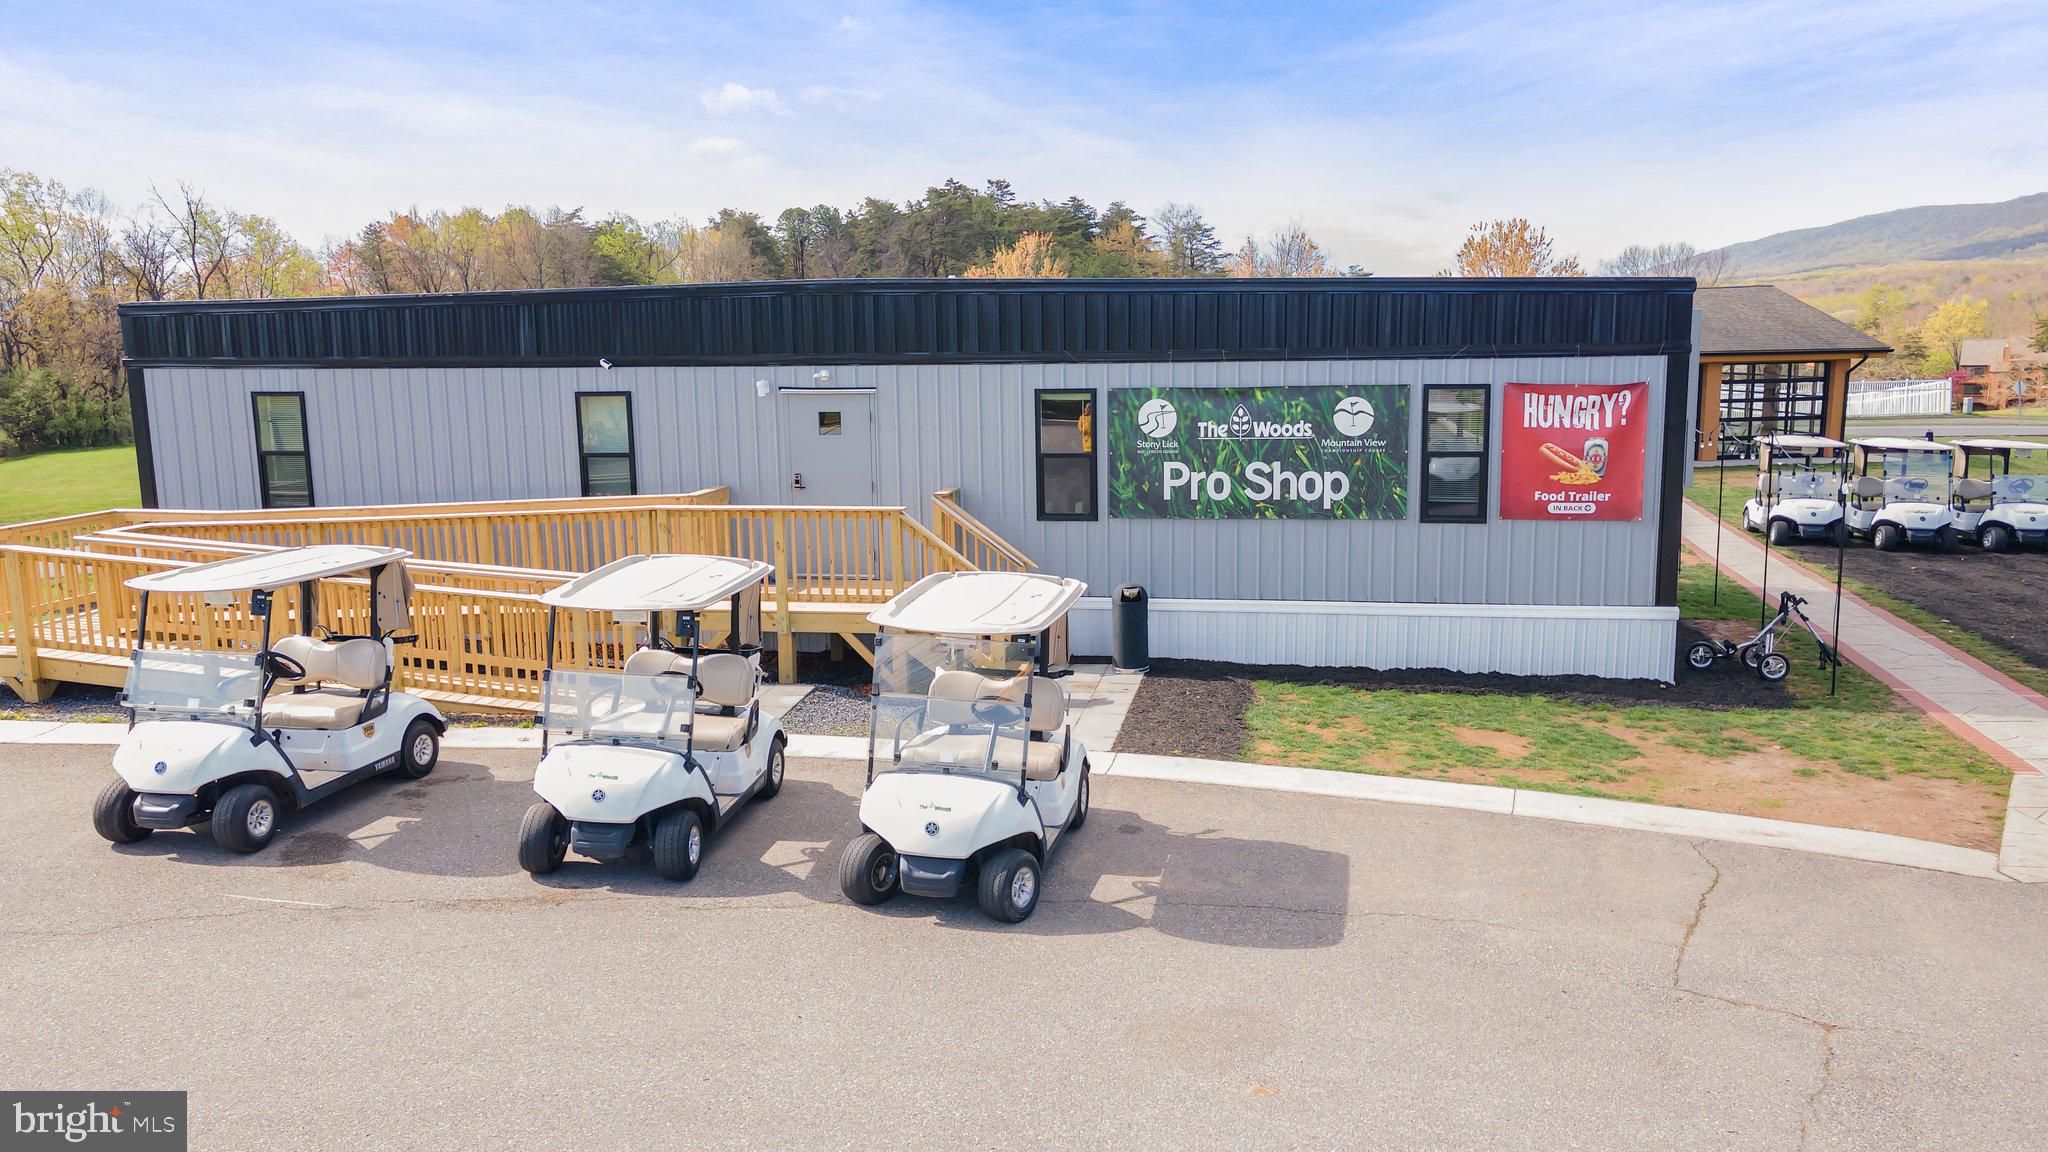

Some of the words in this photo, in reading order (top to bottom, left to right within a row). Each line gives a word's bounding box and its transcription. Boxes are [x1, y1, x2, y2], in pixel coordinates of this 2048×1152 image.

[1523, 390, 1632, 431] HUNGRY?
[1197, 421, 1228, 438] The
[1252, 420, 1313, 438] Woods
[1136, 440, 1161, 450] Stony
[1162, 440, 1179, 448] Lick
[1321, 438, 1362, 447] Mountain
[1363, 438, 1387, 447] View
[1163, 461, 1232, 501] Pro
[1244, 460, 1350, 510] Shop
[1534, 490, 1566, 502] Food
[1568, 490, 1611, 502] Trailer
[374, 756, 396, 771] YAMAHA
